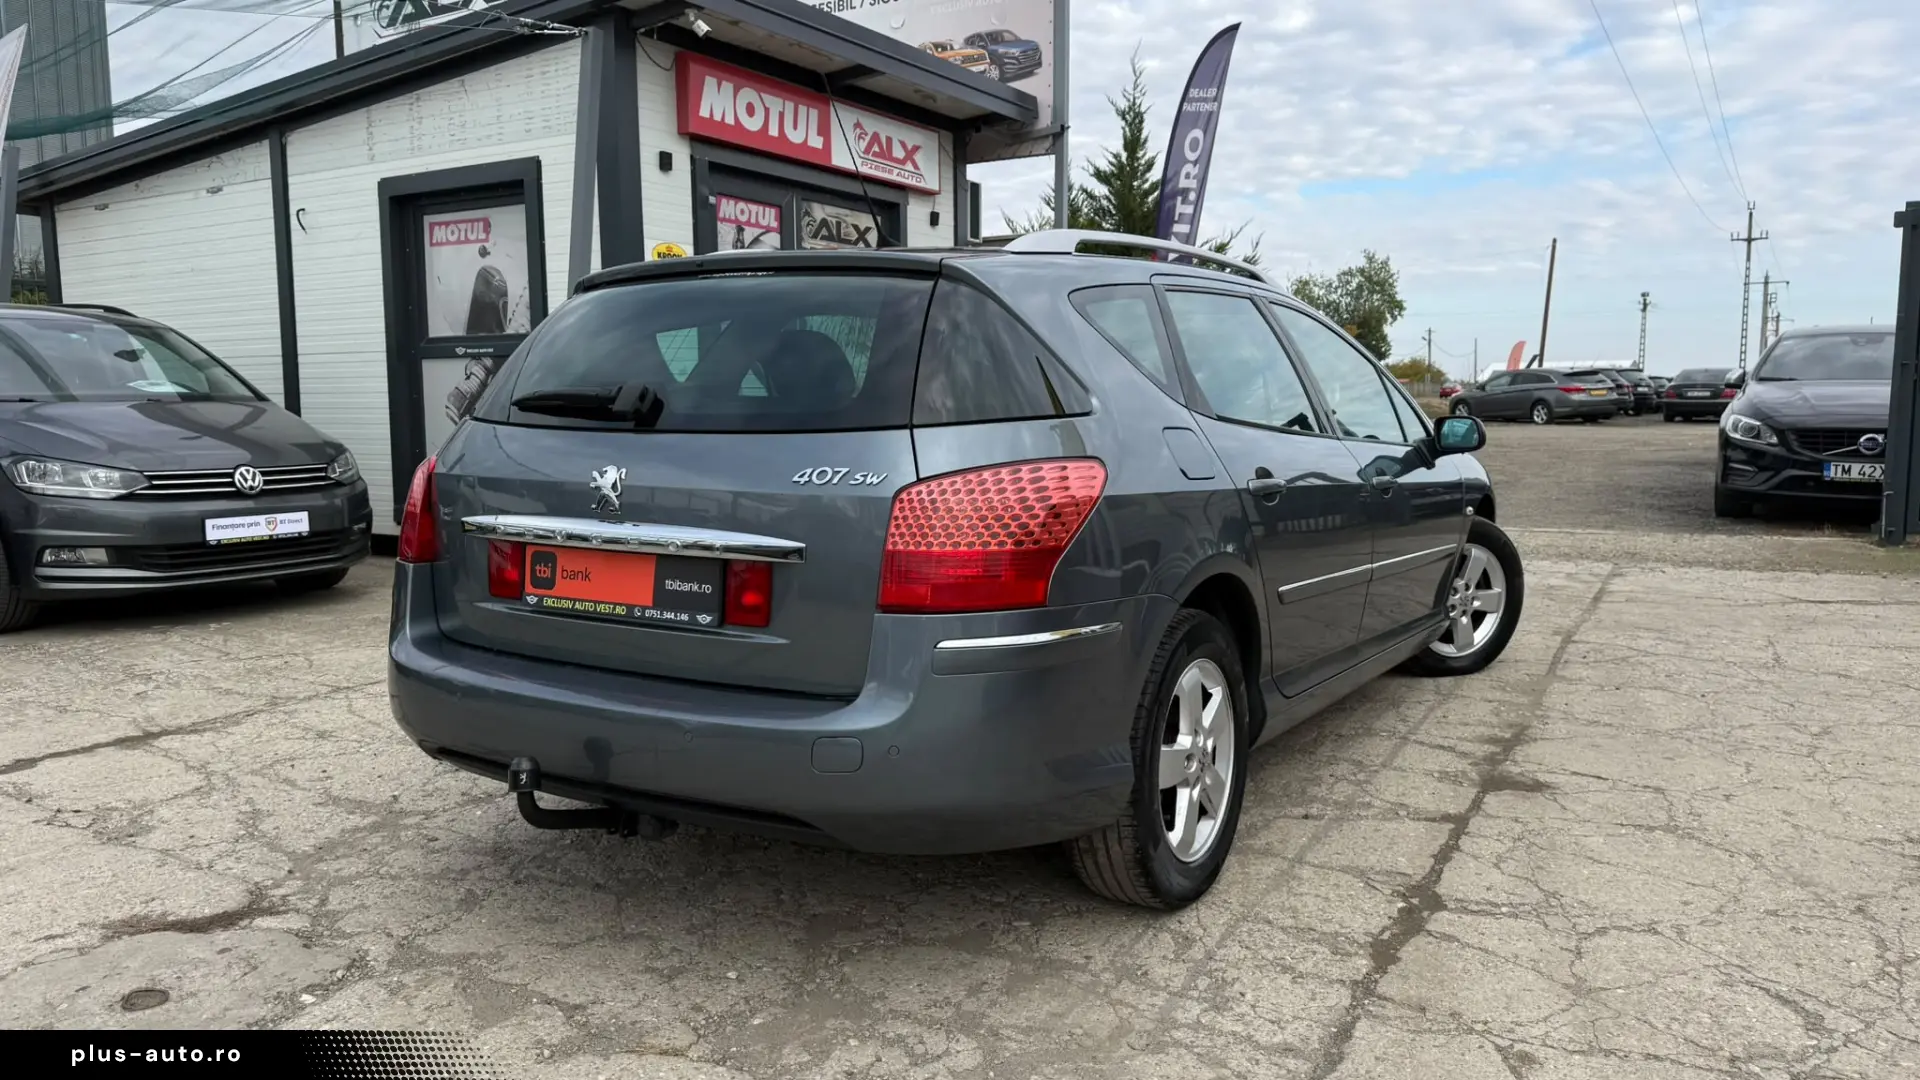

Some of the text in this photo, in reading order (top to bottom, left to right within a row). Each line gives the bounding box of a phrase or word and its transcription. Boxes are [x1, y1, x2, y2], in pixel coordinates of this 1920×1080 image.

[1188, 88, 1218, 98] DEALER
[699, 75, 825, 149] MOTUL
[1182, 101, 1219, 112] PARTENER
[863, 130, 923, 171] ALX
[861, 160, 922, 184] PIESE AUTO
[719, 199, 779, 228] MOTUL
[432, 221, 488, 244] MOTUL
[791, 466, 851, 486] 407
[1832, 464, 1852, 477] TM
[247, 521, 261, 531] prin
[535, 563, 592, 583] tbi bank
[665, 579, 712, 594] tbibank.ro
[543, 597, 689, 622] EXCLUSIV AUTO VEST.RO 0751.344.146
